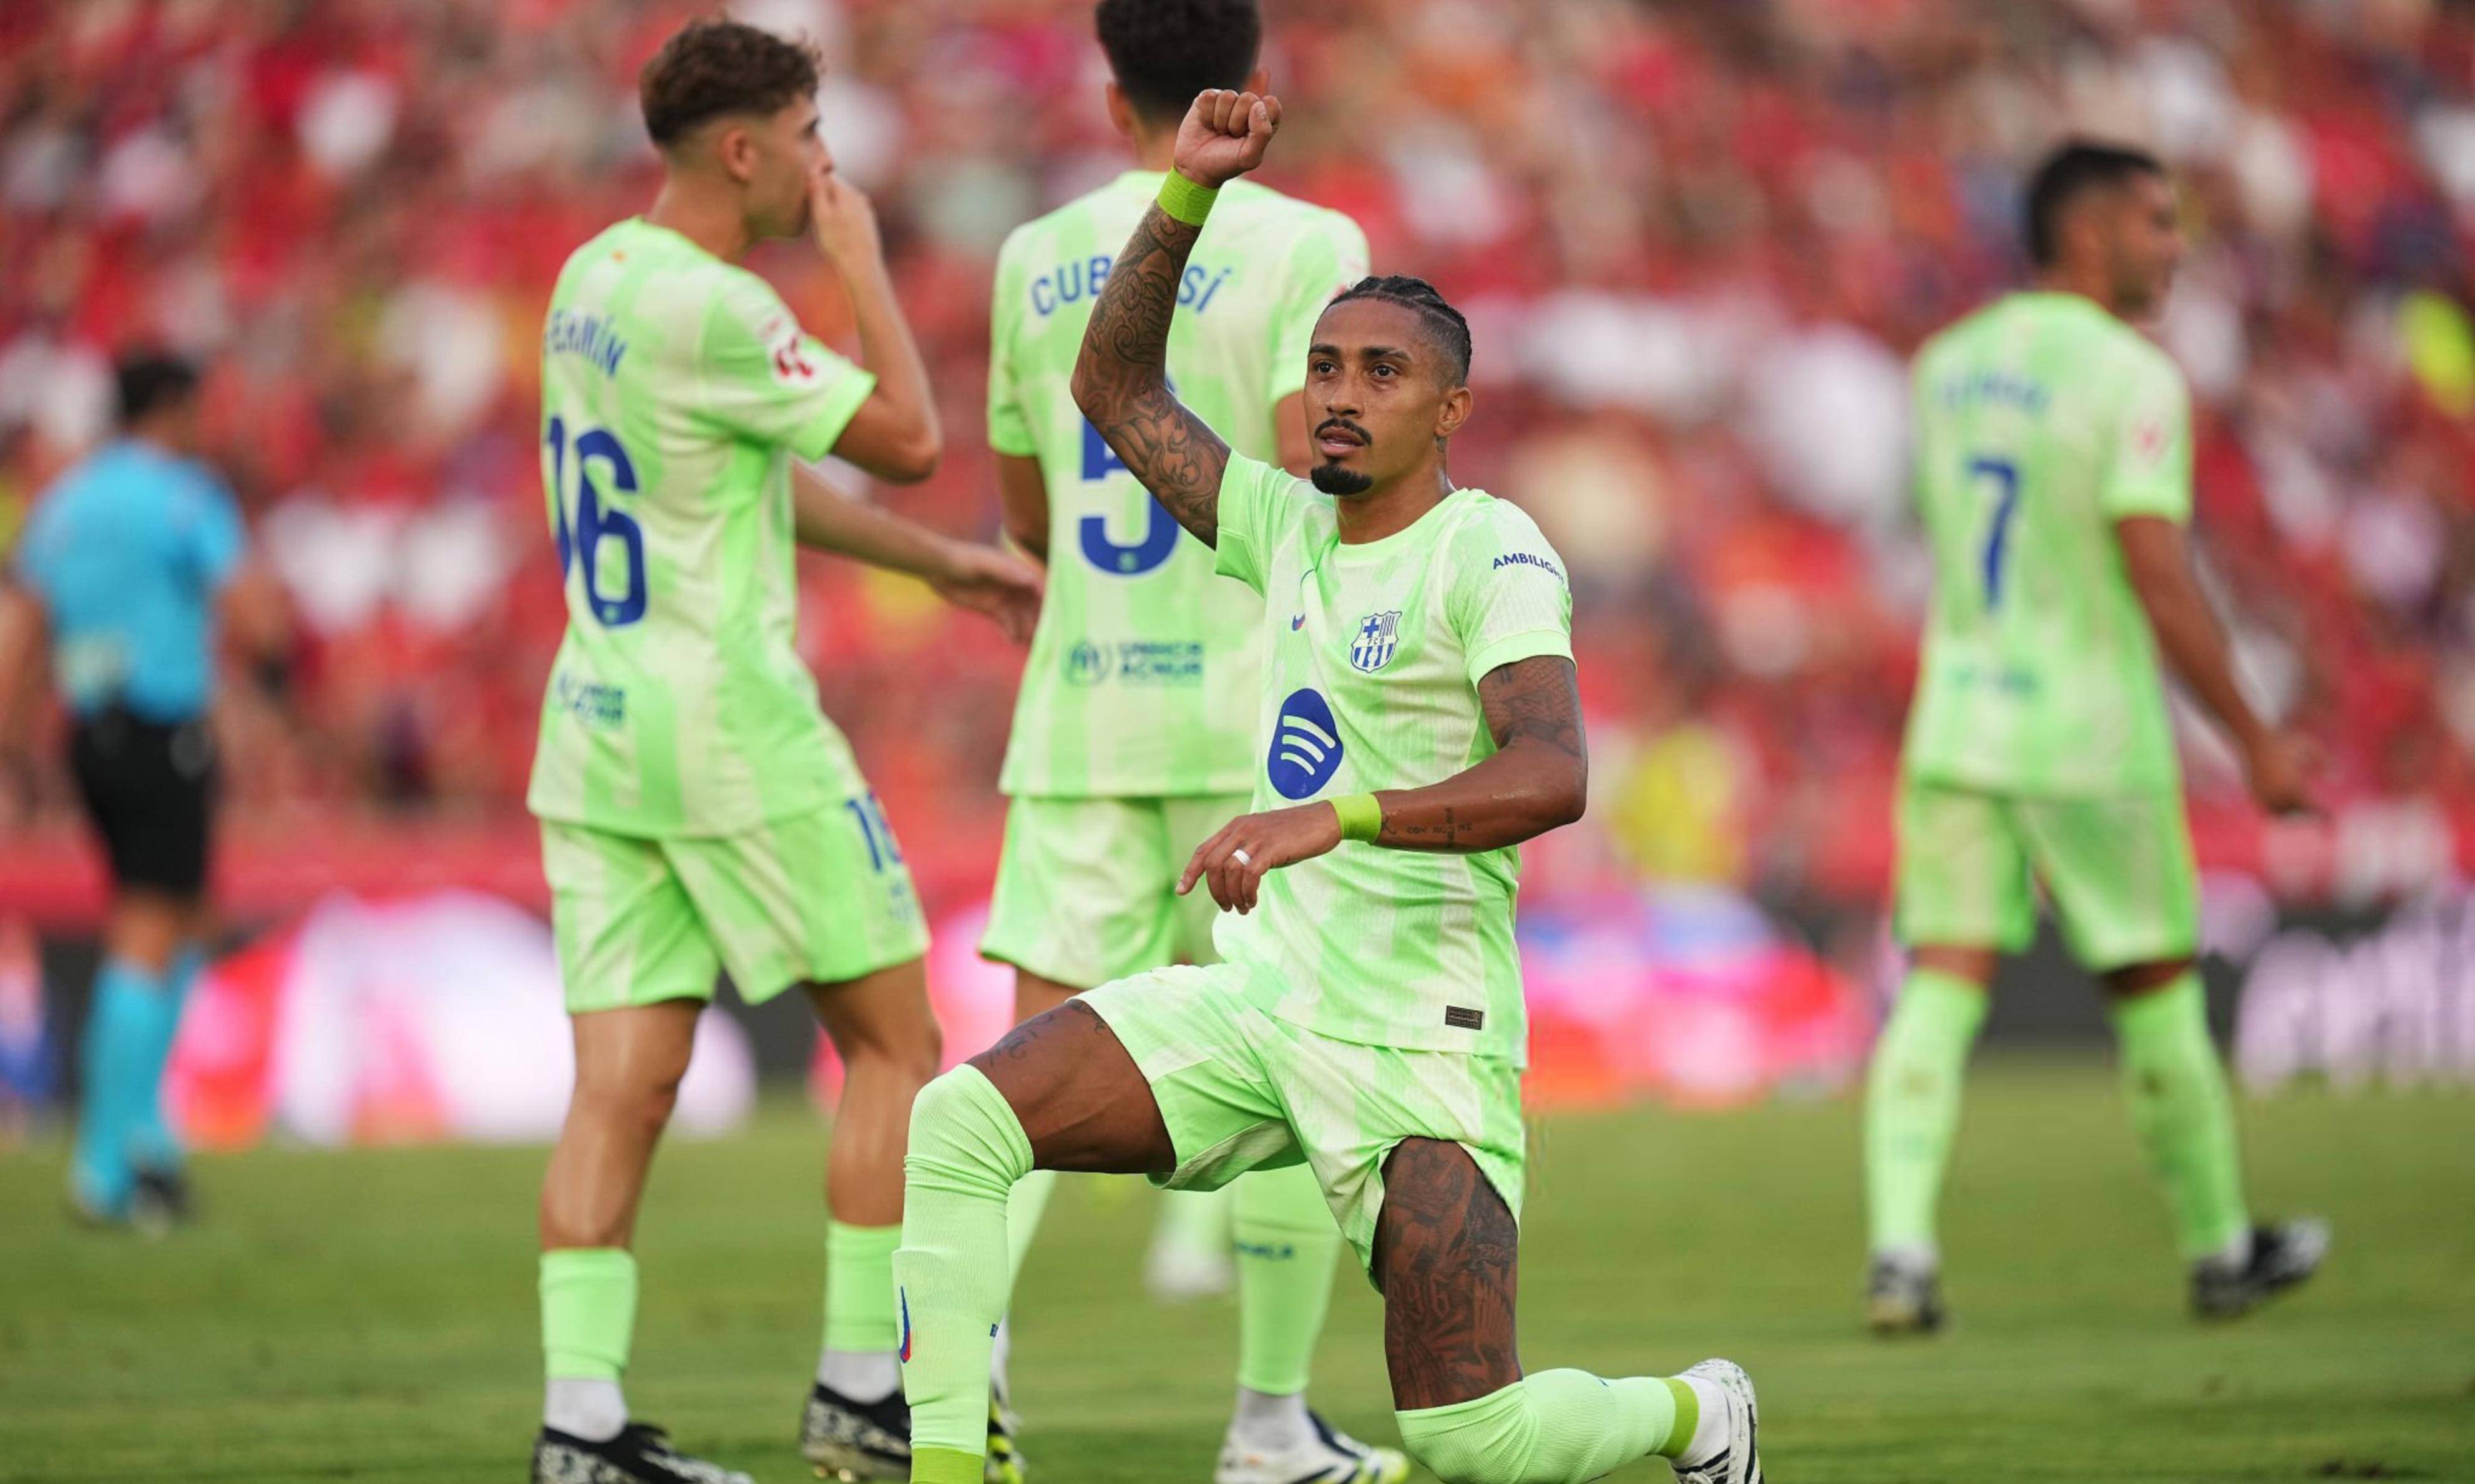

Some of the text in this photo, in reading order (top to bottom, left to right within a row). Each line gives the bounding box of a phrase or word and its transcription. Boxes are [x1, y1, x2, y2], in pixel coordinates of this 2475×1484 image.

[1032, 256, 1231, 316] CUBSÍ
[547, 414, 647, 628] 16
[1080, 373, 1179, 575] 5
[1967, 459, 2018, 613] 7
[1493, 553, 1565, 585] AMBILIGH
